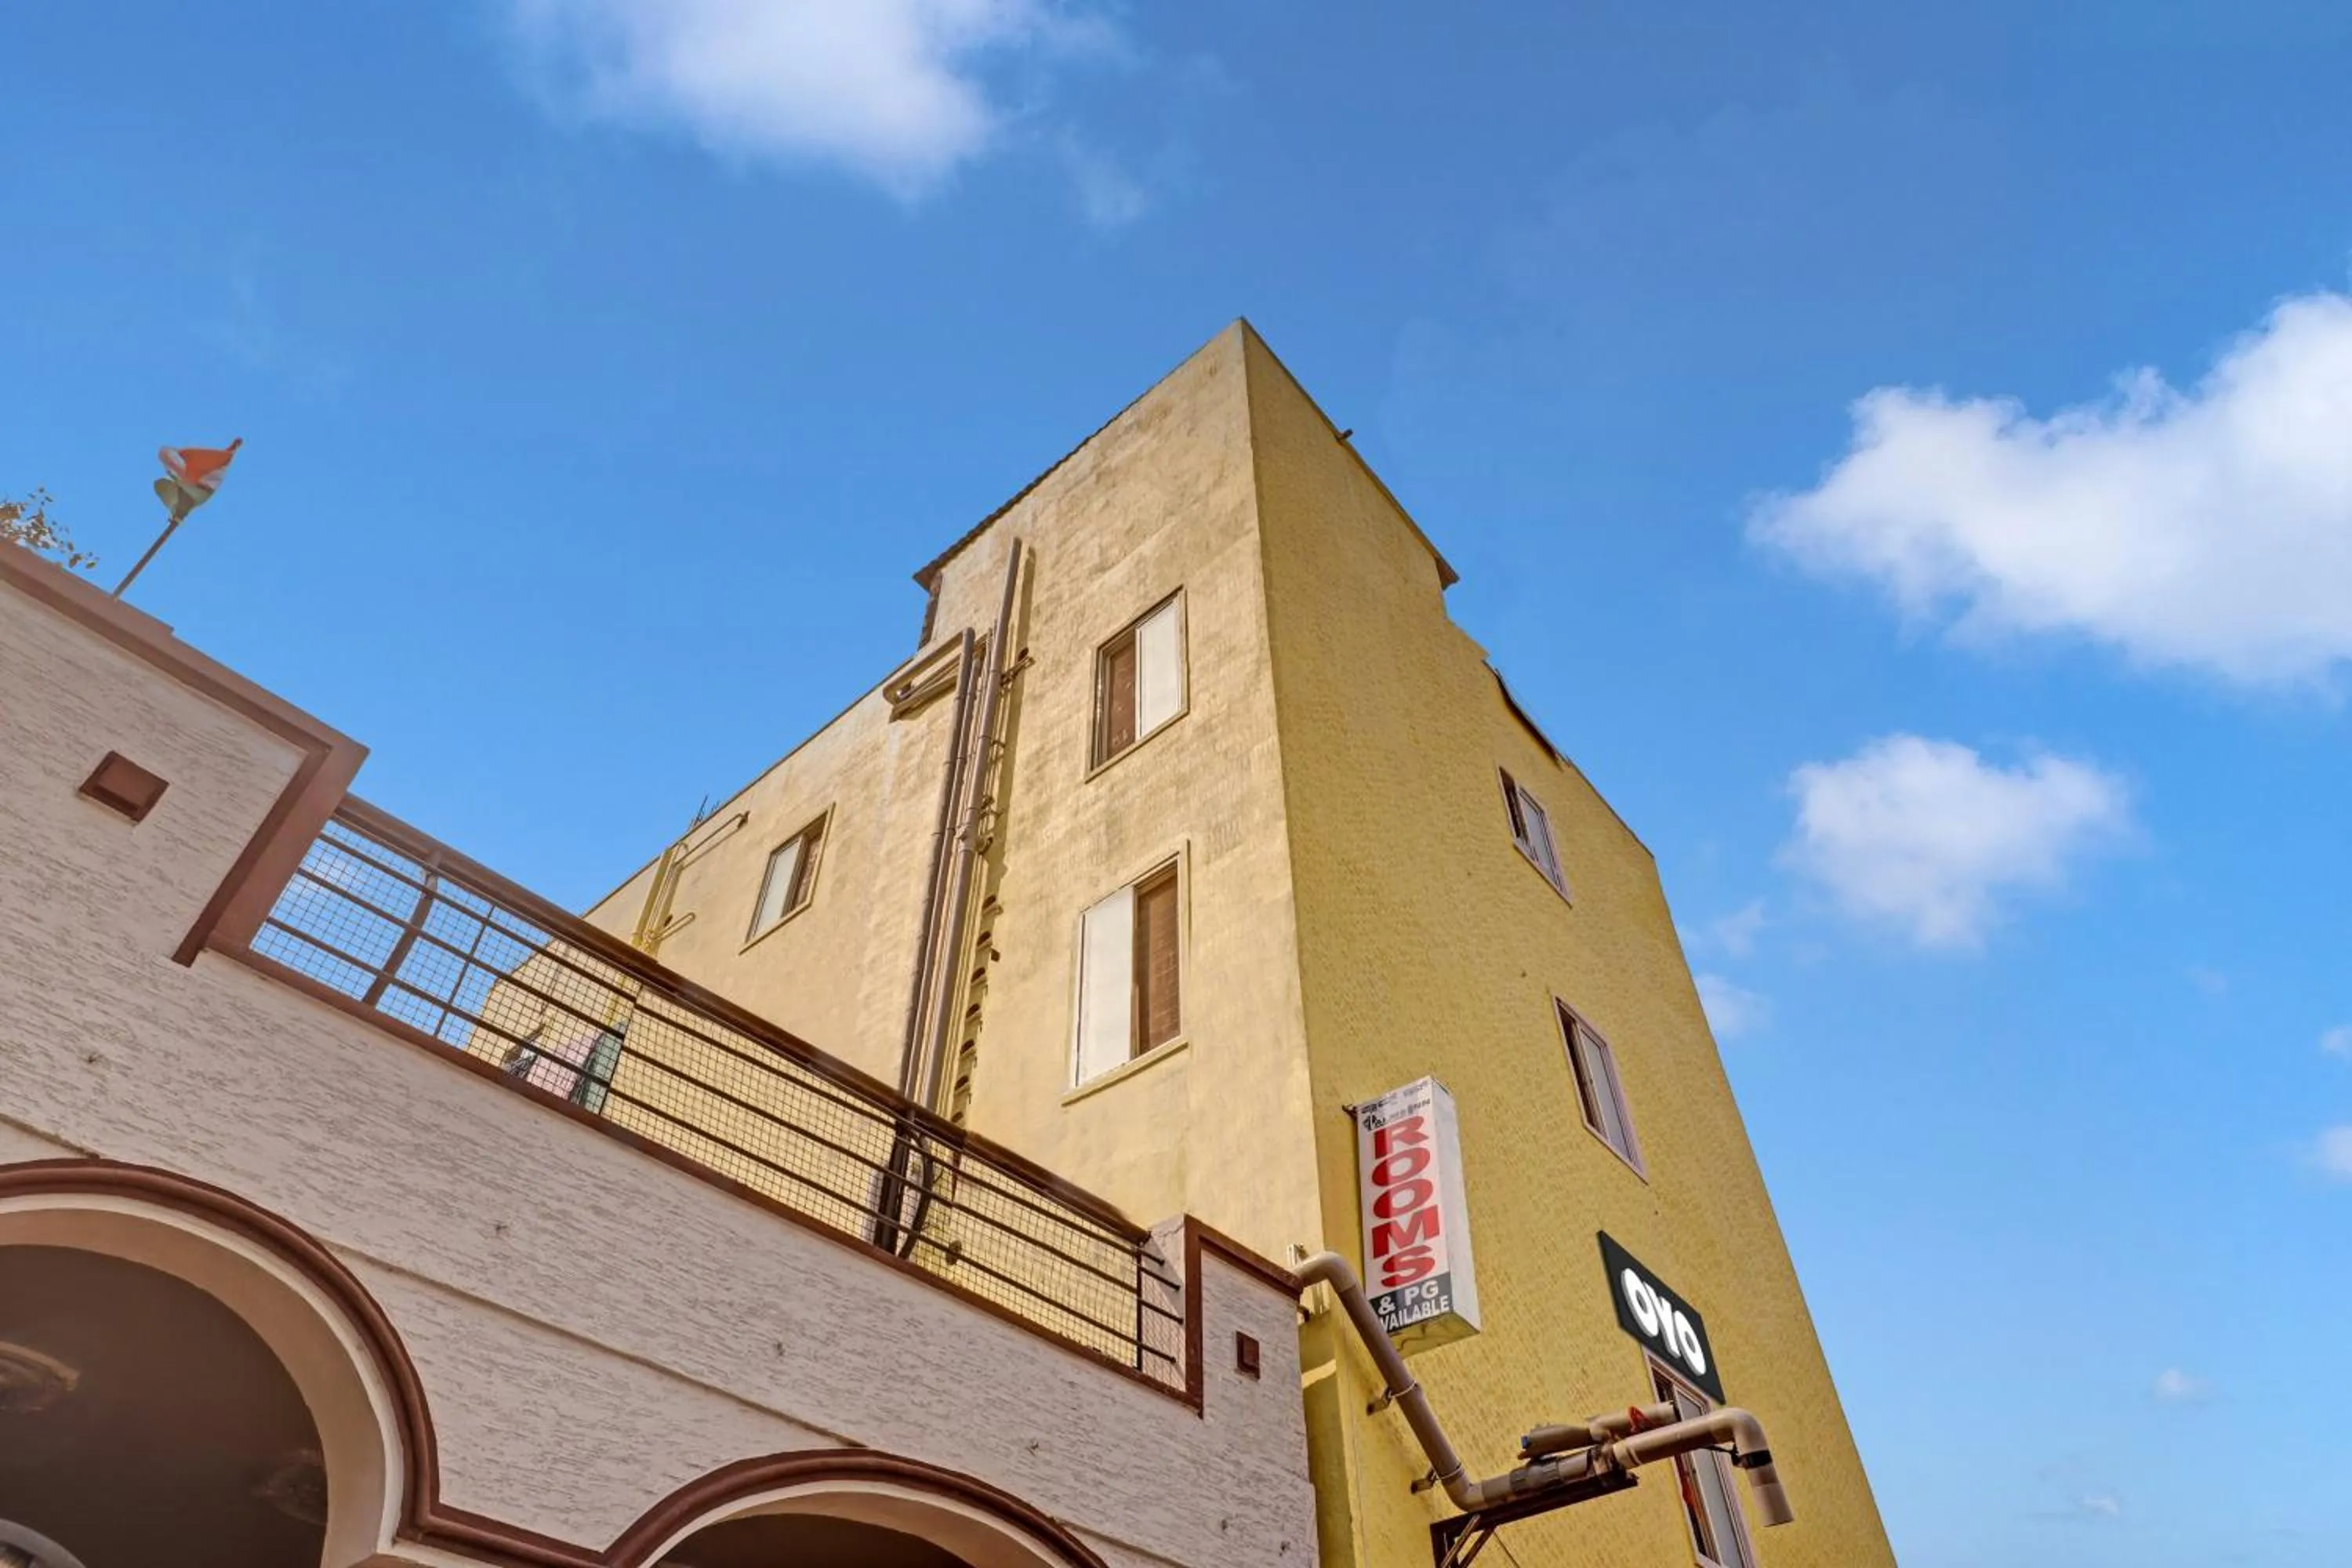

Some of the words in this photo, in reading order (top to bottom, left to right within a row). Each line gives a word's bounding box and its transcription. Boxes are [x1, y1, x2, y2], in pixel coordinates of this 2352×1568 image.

[1372, 1116, 1439, 1288] ROOMS
[1378, 1296, 1396, 1315] &
[1404, 1279, 1439, 1306] PG
[1379, 1295, 1450, 1332] VAILABLE
[1621, 1268, 1706, 1376] OYO
